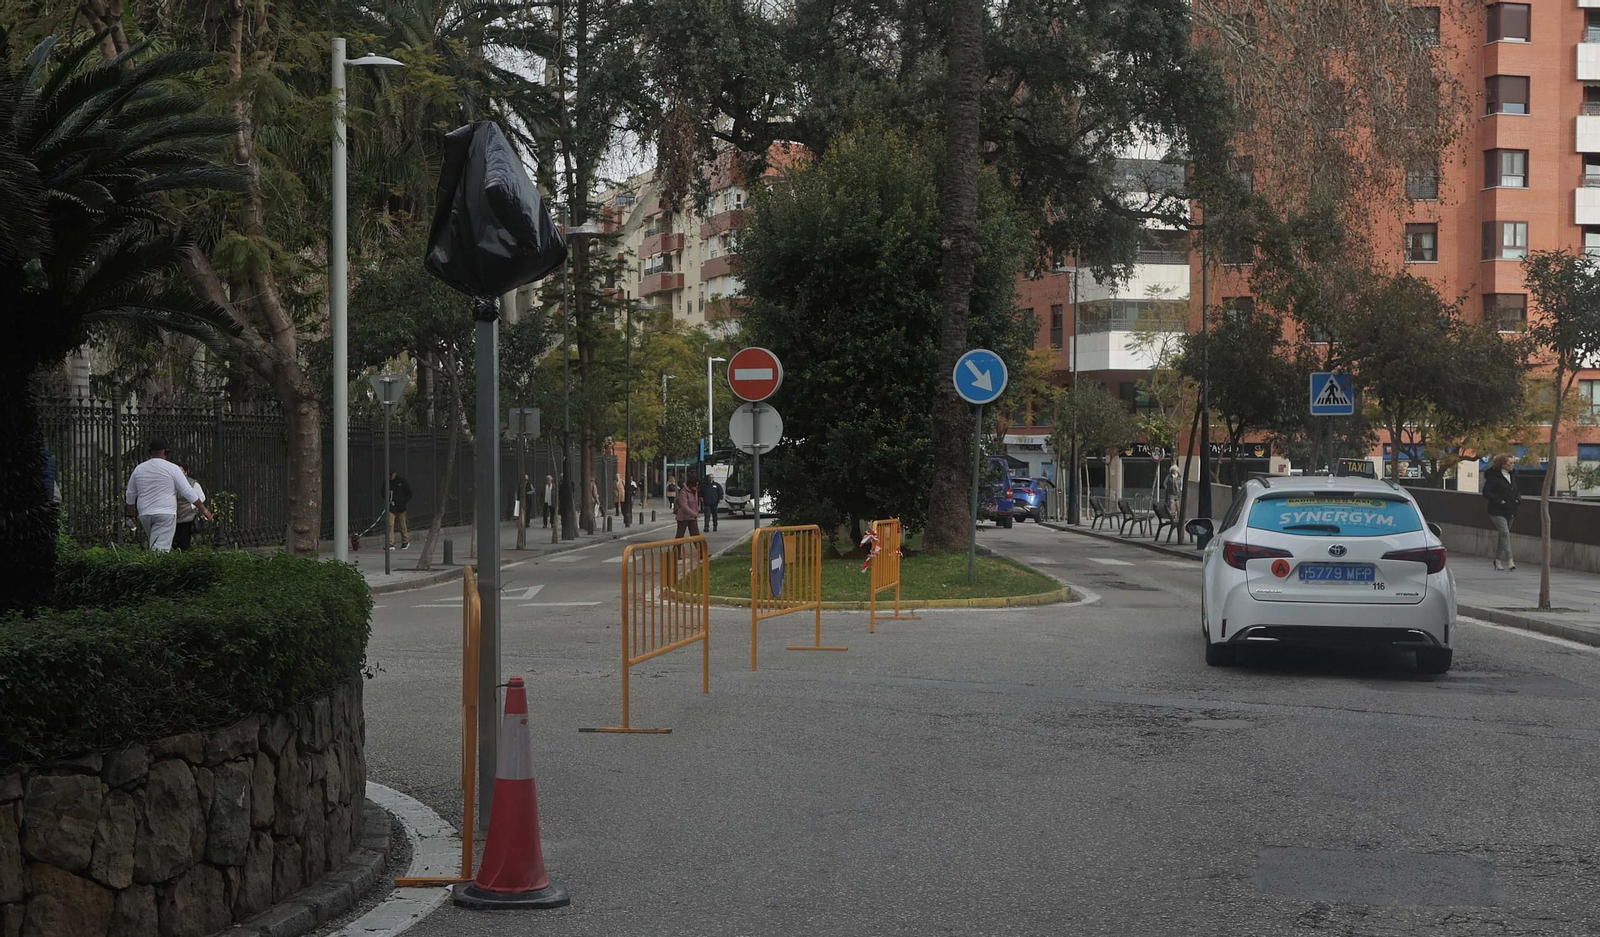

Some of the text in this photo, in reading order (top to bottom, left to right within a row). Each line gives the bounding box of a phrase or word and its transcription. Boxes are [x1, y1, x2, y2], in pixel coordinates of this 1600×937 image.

[1348, 461, 1365, 473] TAXI
[1279, 511, 1394, 526] SYNERGYM
[1275, 562, 1286, 574] A
[1307, 566, 1372, 580] 5779 MFP
[1372, 582, 1385, 591] 116
